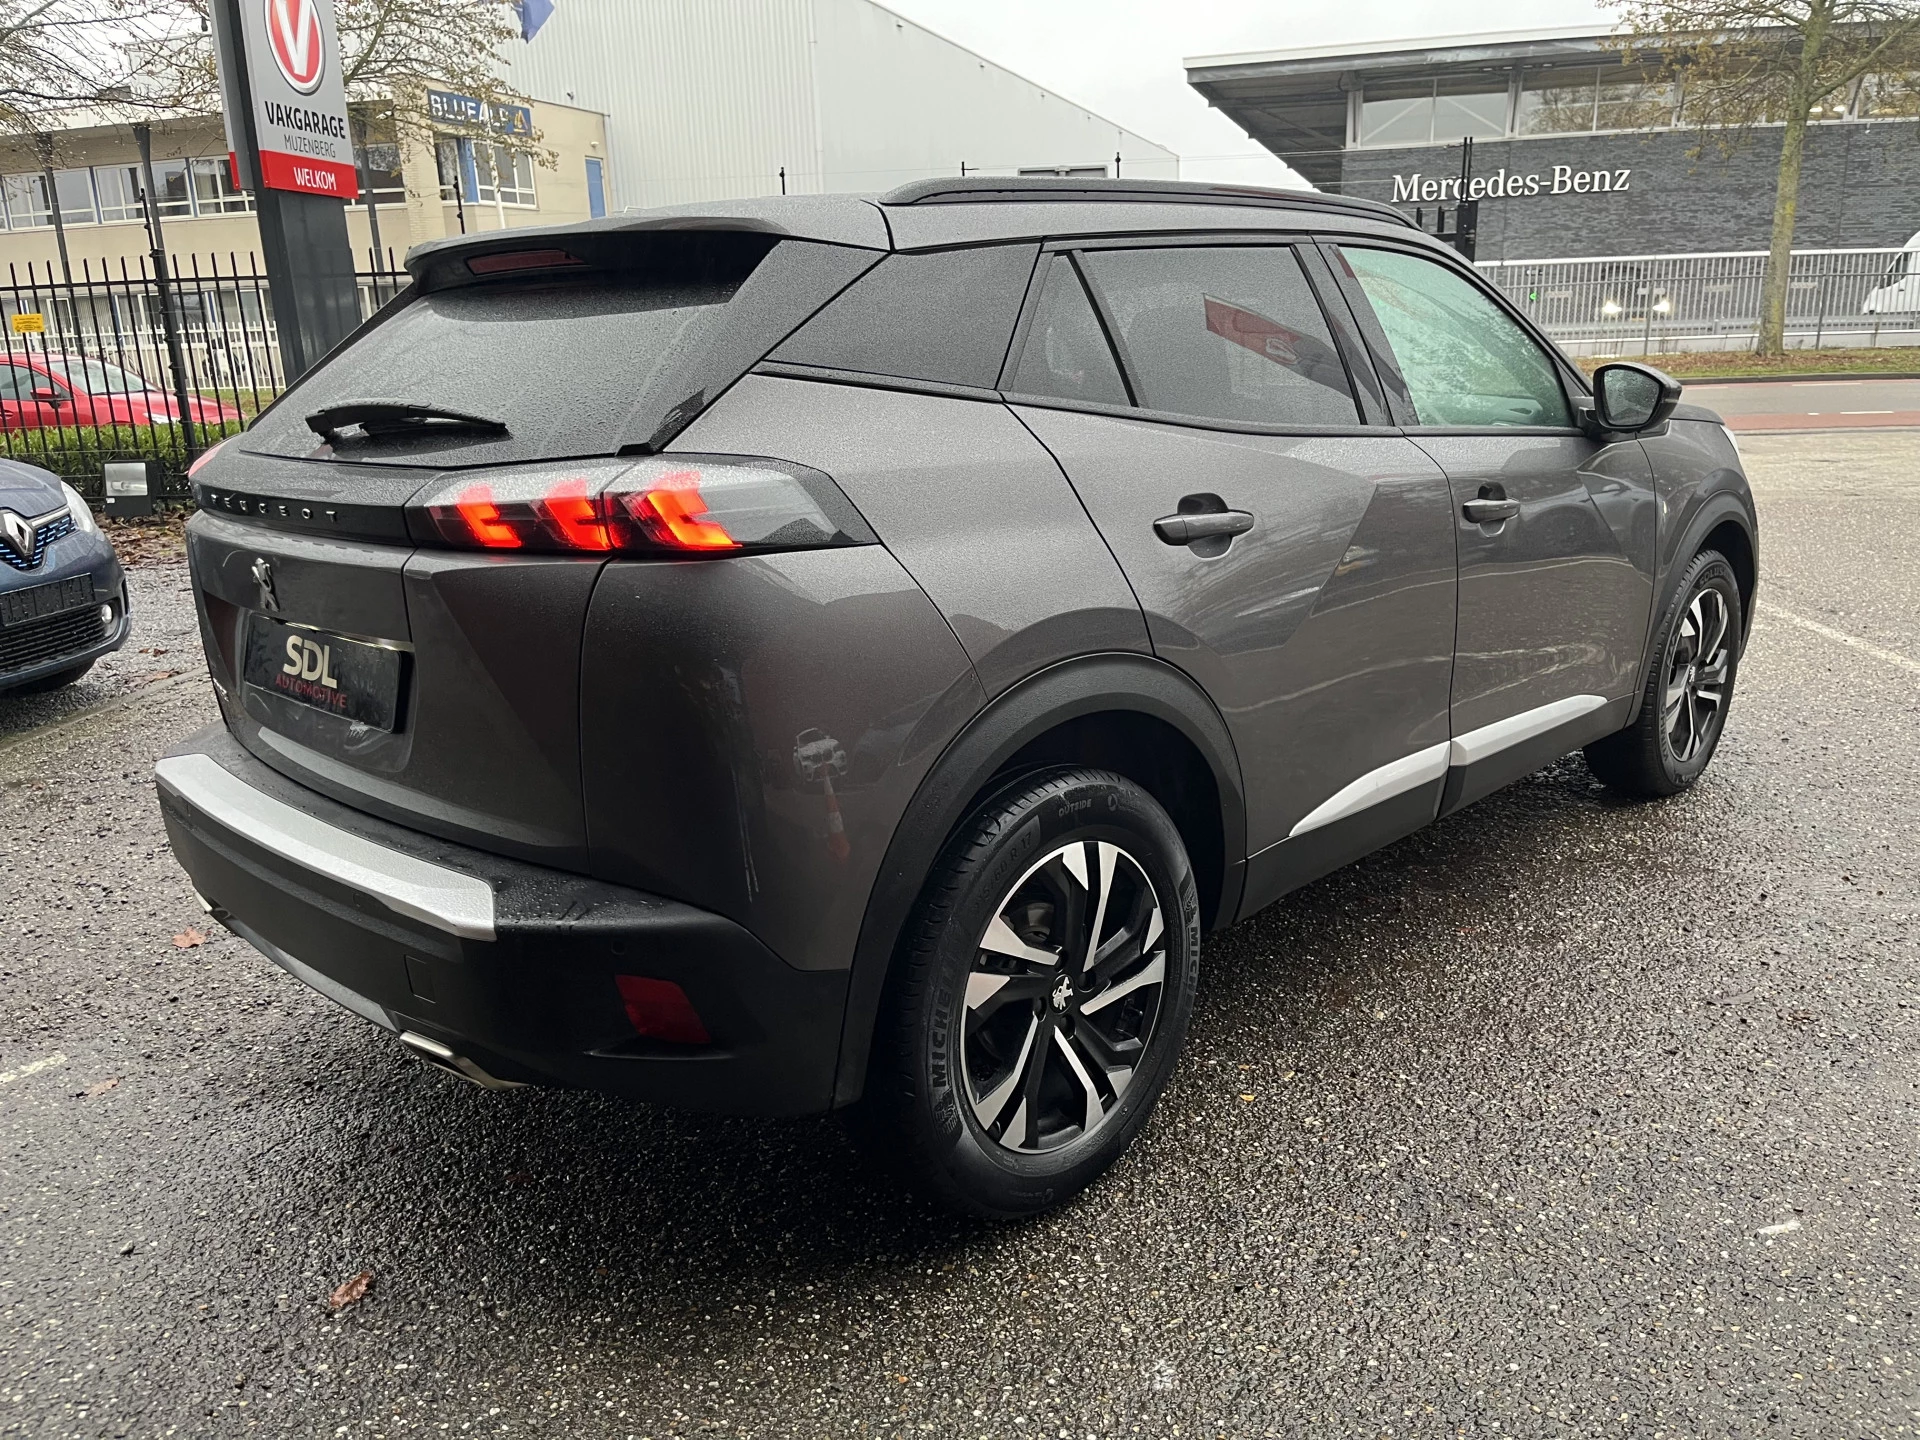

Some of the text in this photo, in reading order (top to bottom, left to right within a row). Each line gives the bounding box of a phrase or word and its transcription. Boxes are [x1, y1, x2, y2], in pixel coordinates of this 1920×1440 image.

[264, 100, 346, 139] VAKGARAGE
[283, 133, 336, 158] MUZENBERG
[293, 166, 337, 191] WELKOM
[1390, 164, 1631, 203] Mercedes-Benz
[210, 493, 337, 522] PEUGEOT
[282, 634, 338, 689] SDL
[275, 673, 347, 709] AUTOMOTIVE
[1057, 798, 1093, 818] OUTSIDE
